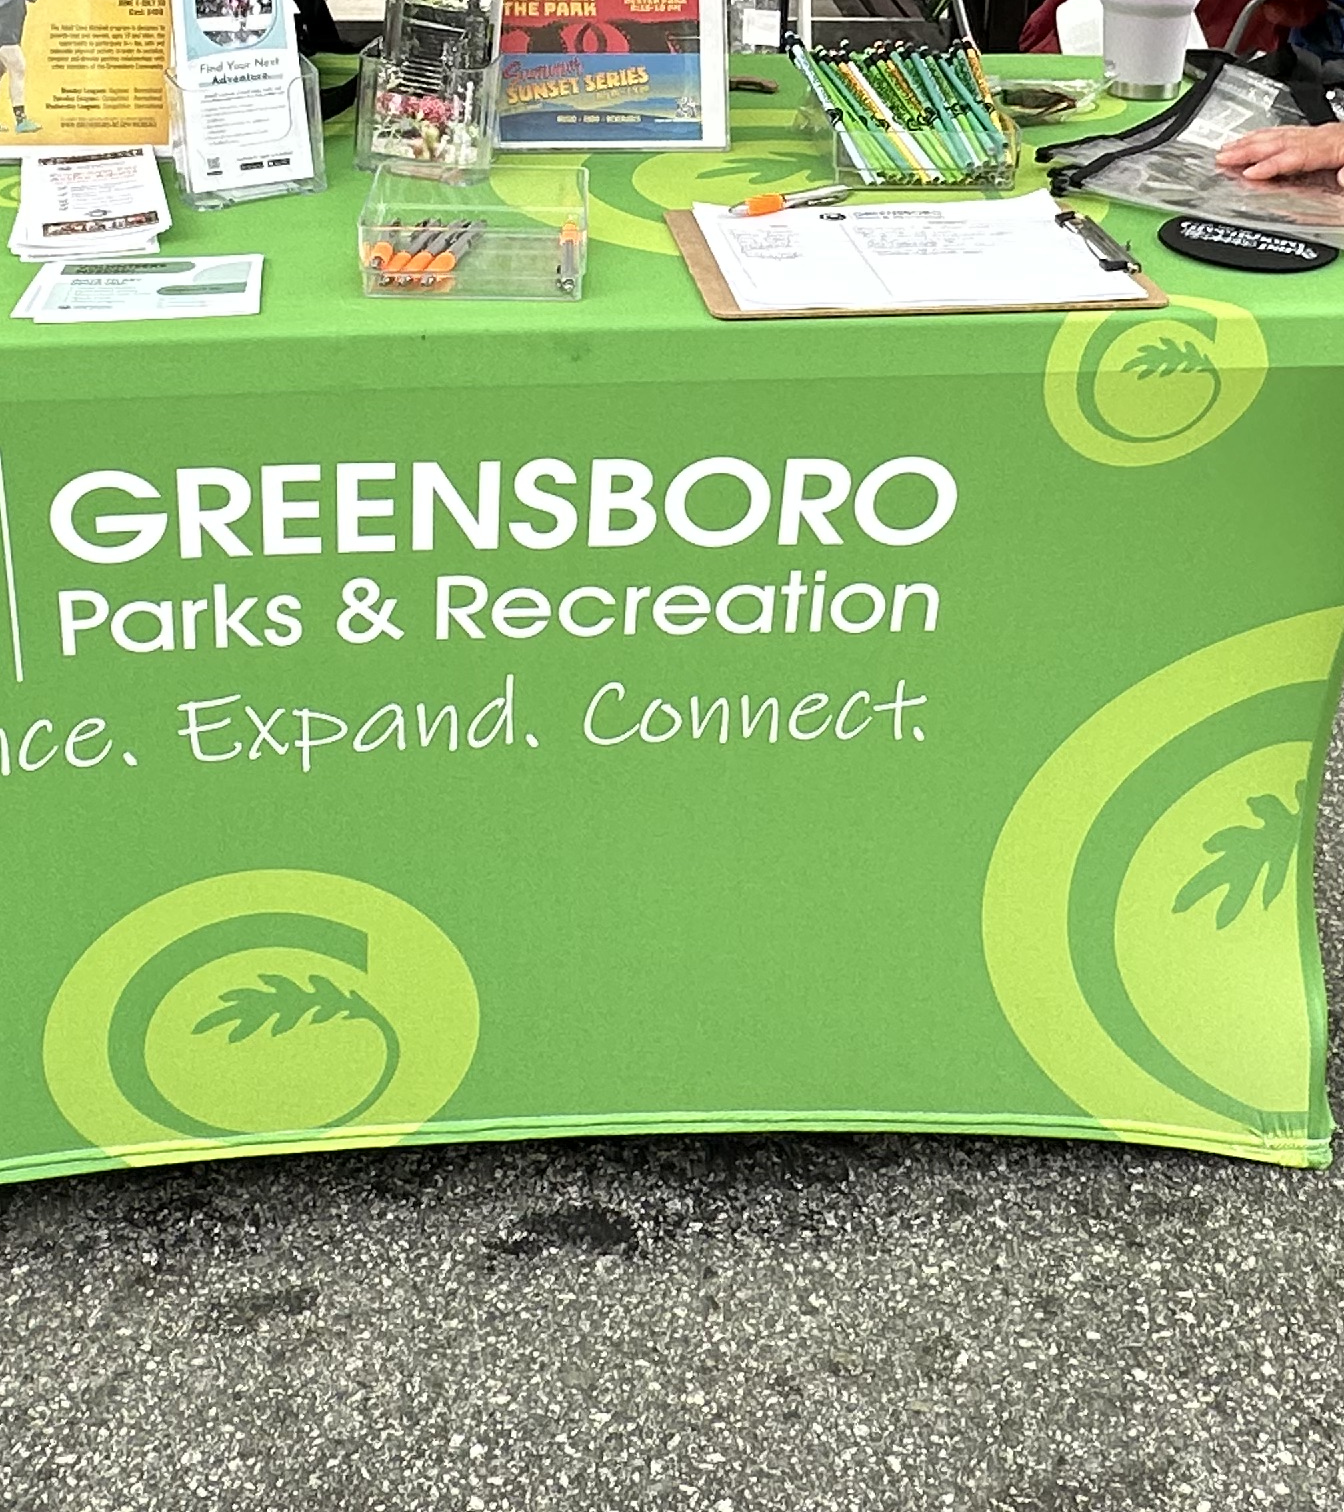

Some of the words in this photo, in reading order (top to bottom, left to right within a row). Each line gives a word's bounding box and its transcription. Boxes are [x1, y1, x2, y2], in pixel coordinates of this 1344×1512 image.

[503, 2, 539, 16] THE
[544, 2, 597, 16] PARK
[200, 61, 223, 73] Find
[226, 60, 251, 70] Your
[255, 57, 279, 67] Next
[506, 77, 580, 104] SUNSET
[585, 66, 650, 92] SERIES
[50, 456, 958, 564] GREENSBORO
[58, 583, 302, 656] Parks
[336, 578, 404, 644] &
[436, 570, 940, 640] Recreation
[177, 674, 539, 772] Expand.
[584, 679, 927, 745] Connect.
